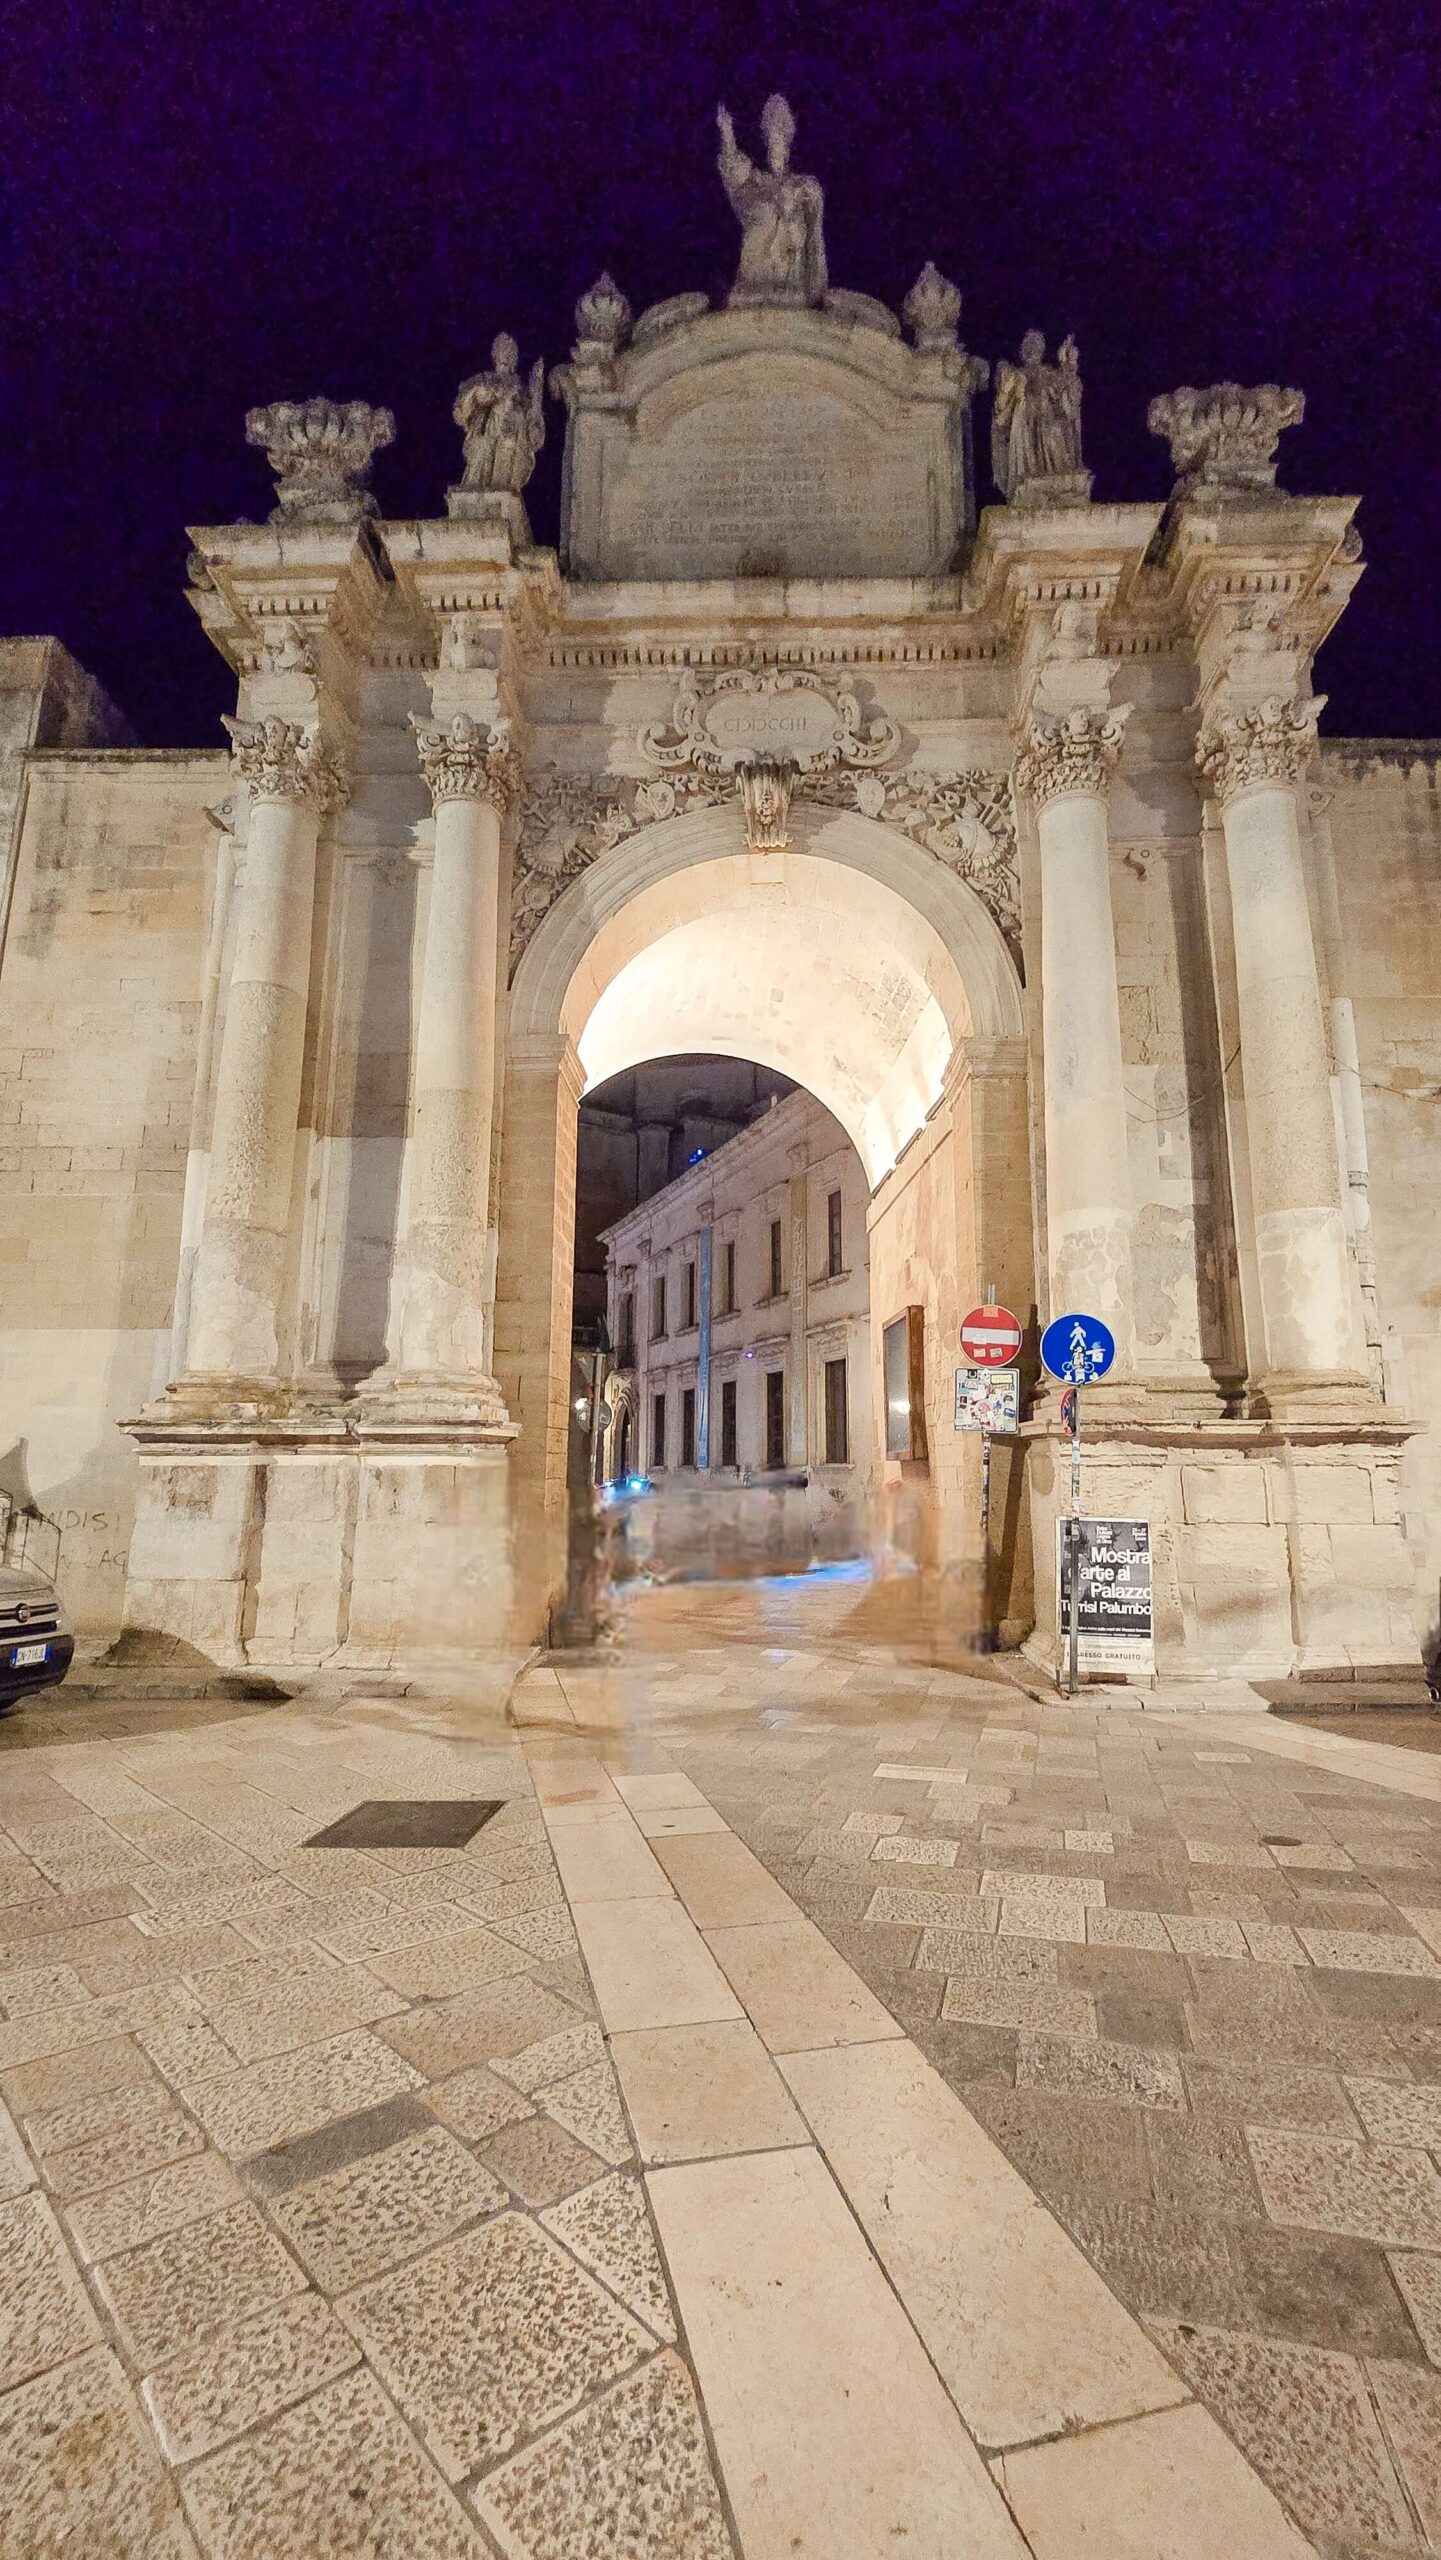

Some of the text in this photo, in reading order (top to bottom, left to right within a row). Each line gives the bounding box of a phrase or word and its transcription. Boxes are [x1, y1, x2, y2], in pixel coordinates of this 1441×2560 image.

[1091, 1546, 1151, 1565] Mostra
[1068, 1562, 1131, 1582] 'arte al
[1090, 1582, 1151, 1600] Palazzo
[1099, 1601, 1151, 1616] Palumbo
[1067, 1650, 1142, 1661] IRESSO GRATUITO
